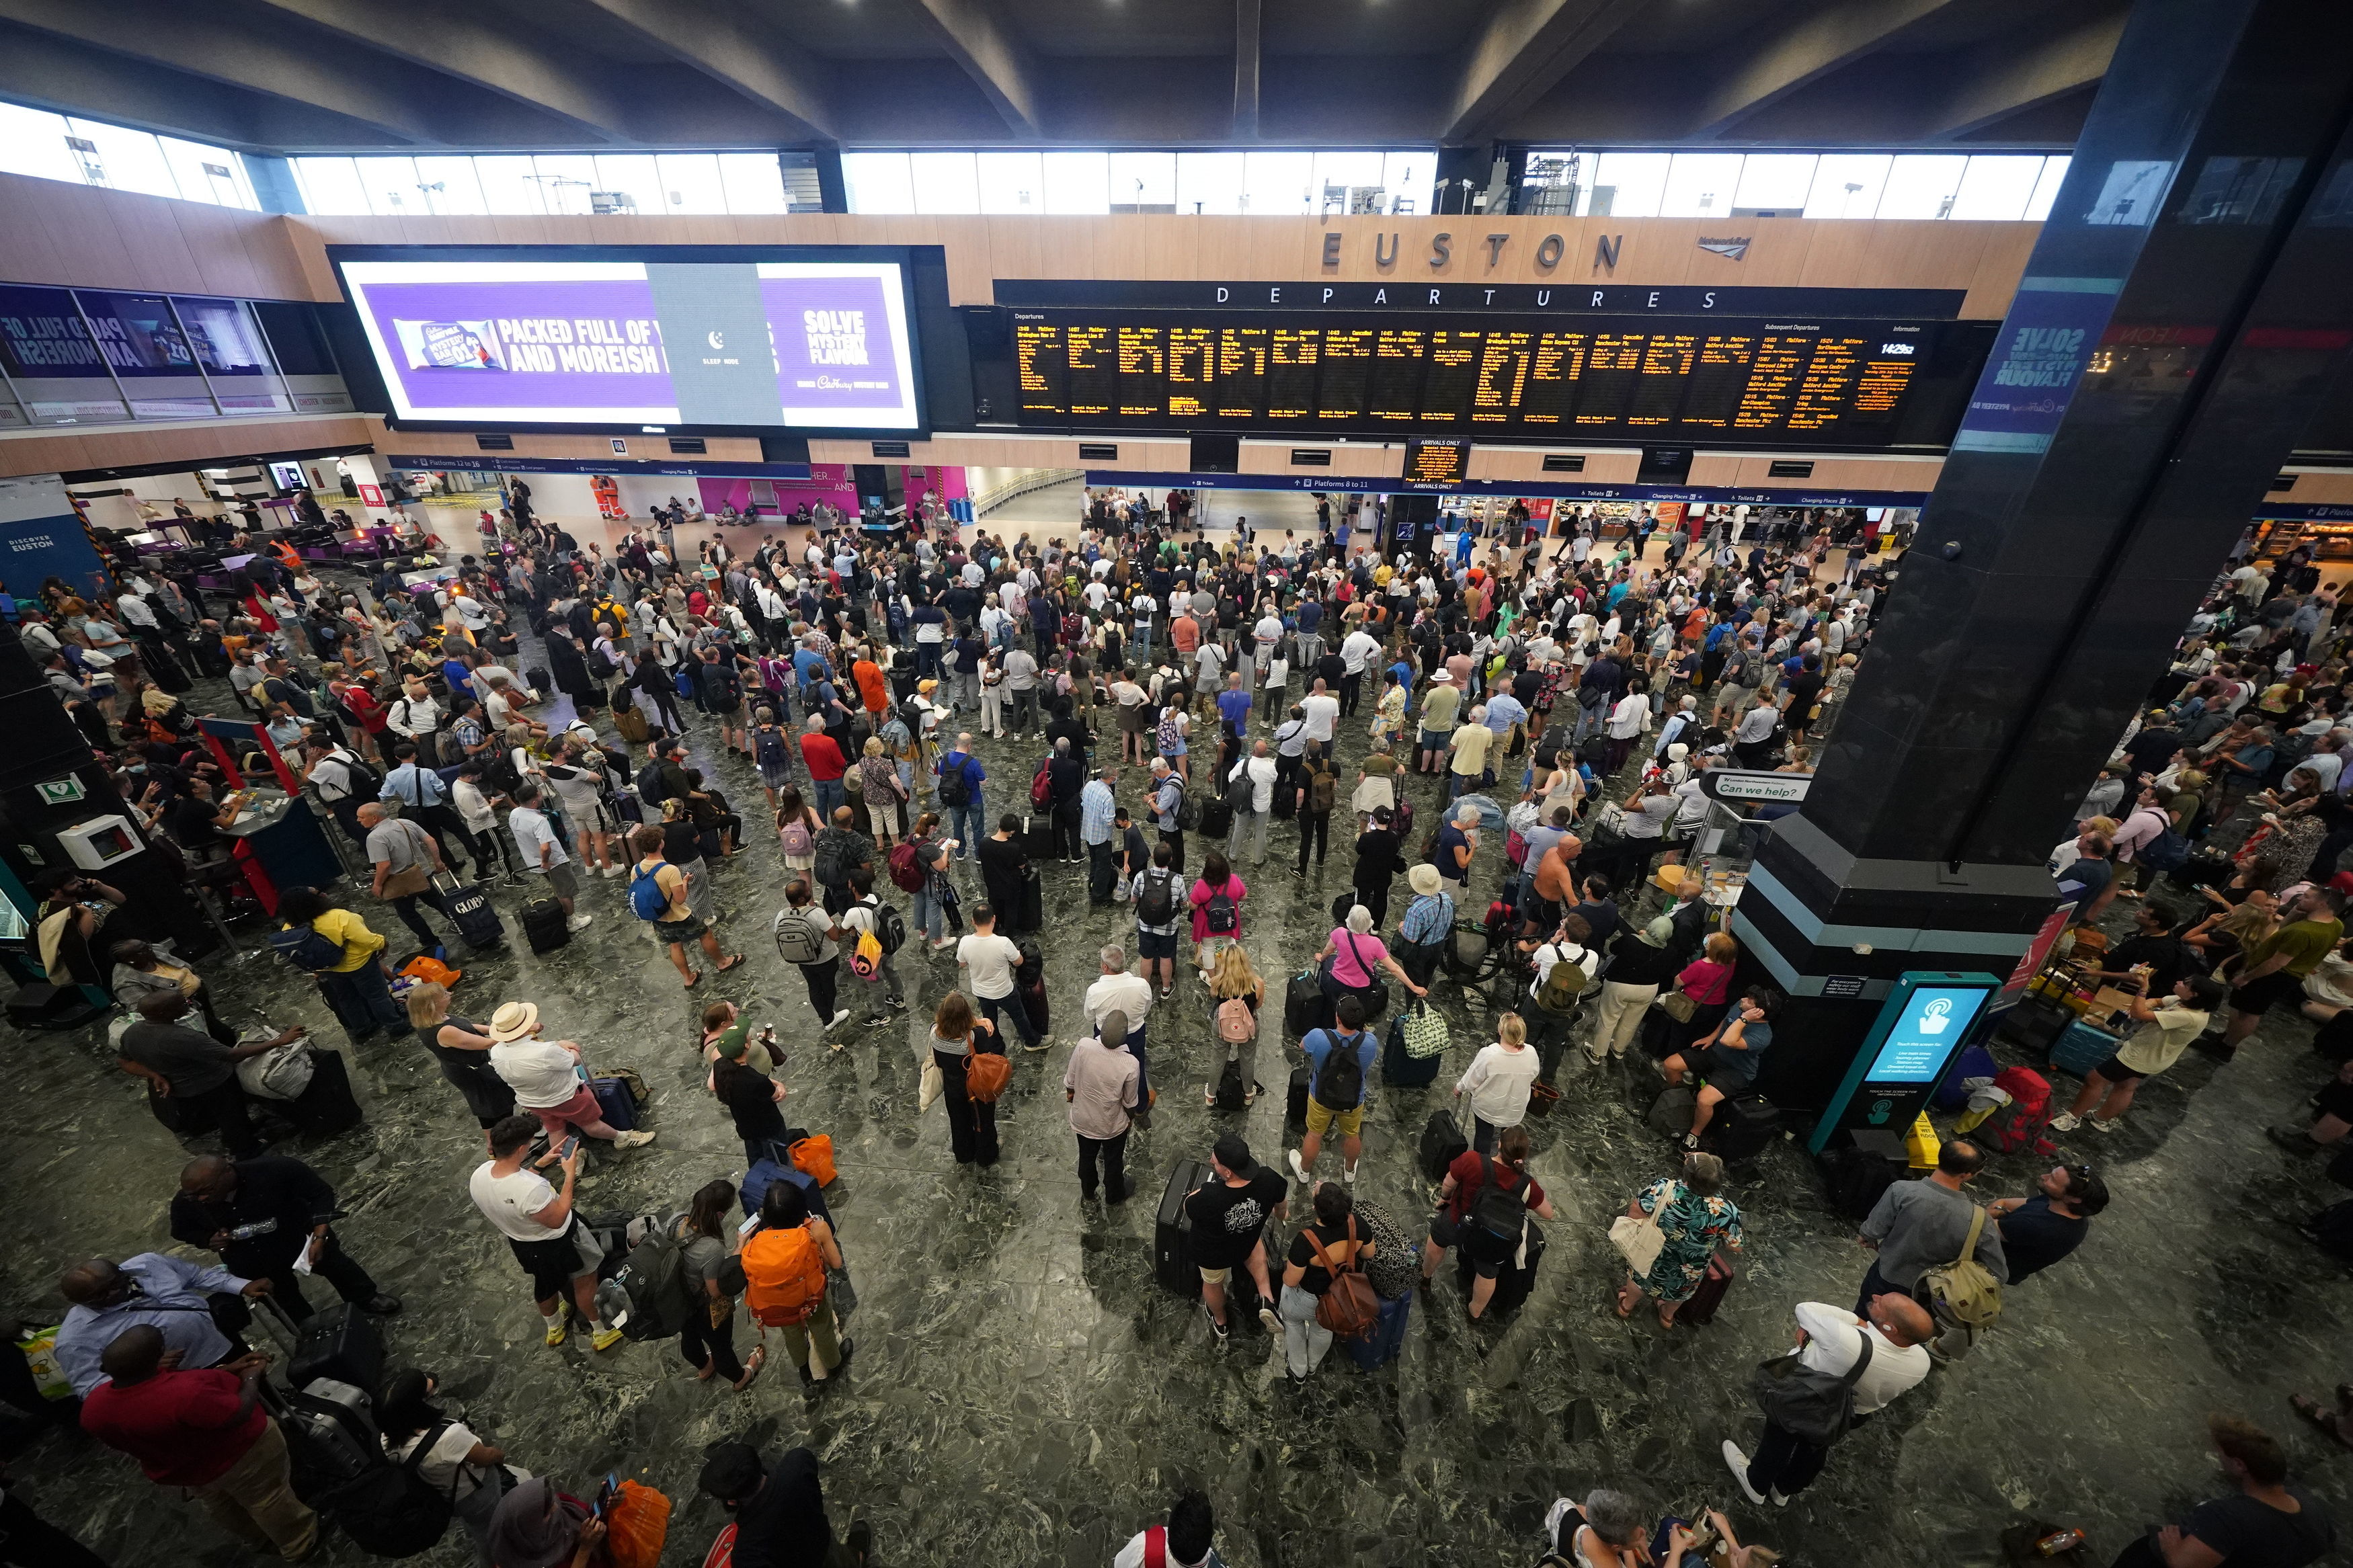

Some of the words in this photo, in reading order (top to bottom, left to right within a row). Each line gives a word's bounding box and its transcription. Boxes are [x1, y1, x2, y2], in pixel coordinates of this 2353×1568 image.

[1322, 233, 1623, 267] EUSTON
[1217, 287, 1715, 308] DEPARTURES
[804, 310, 866, 334] SOLVE
[497, 319, 573, 343] PACKED
[574, 319, 625, 344] FULL
[625, 320, 651, 344] OF
[429, 334, 464, 353] MYSTERY
[807, 333, 866, 349] MYSTERY
[433, 349, 453, 360] BAR
[451, 343, 475, 363] 01
[509, 344, 557, 372] AND
[557, 345, 660, 373] MOREISH
[809, 349, 869, 366] FLAVOUR
[817, 376, 853, 391] Cadbury
[834, 483, 854, 492] AND
[8, 535, 51, 545] DISCOVER
[11, 540, 54, 552] EUSTON
[1720, 784, 1742, 793] Can
[1765, 787, 1797, 798] help?
